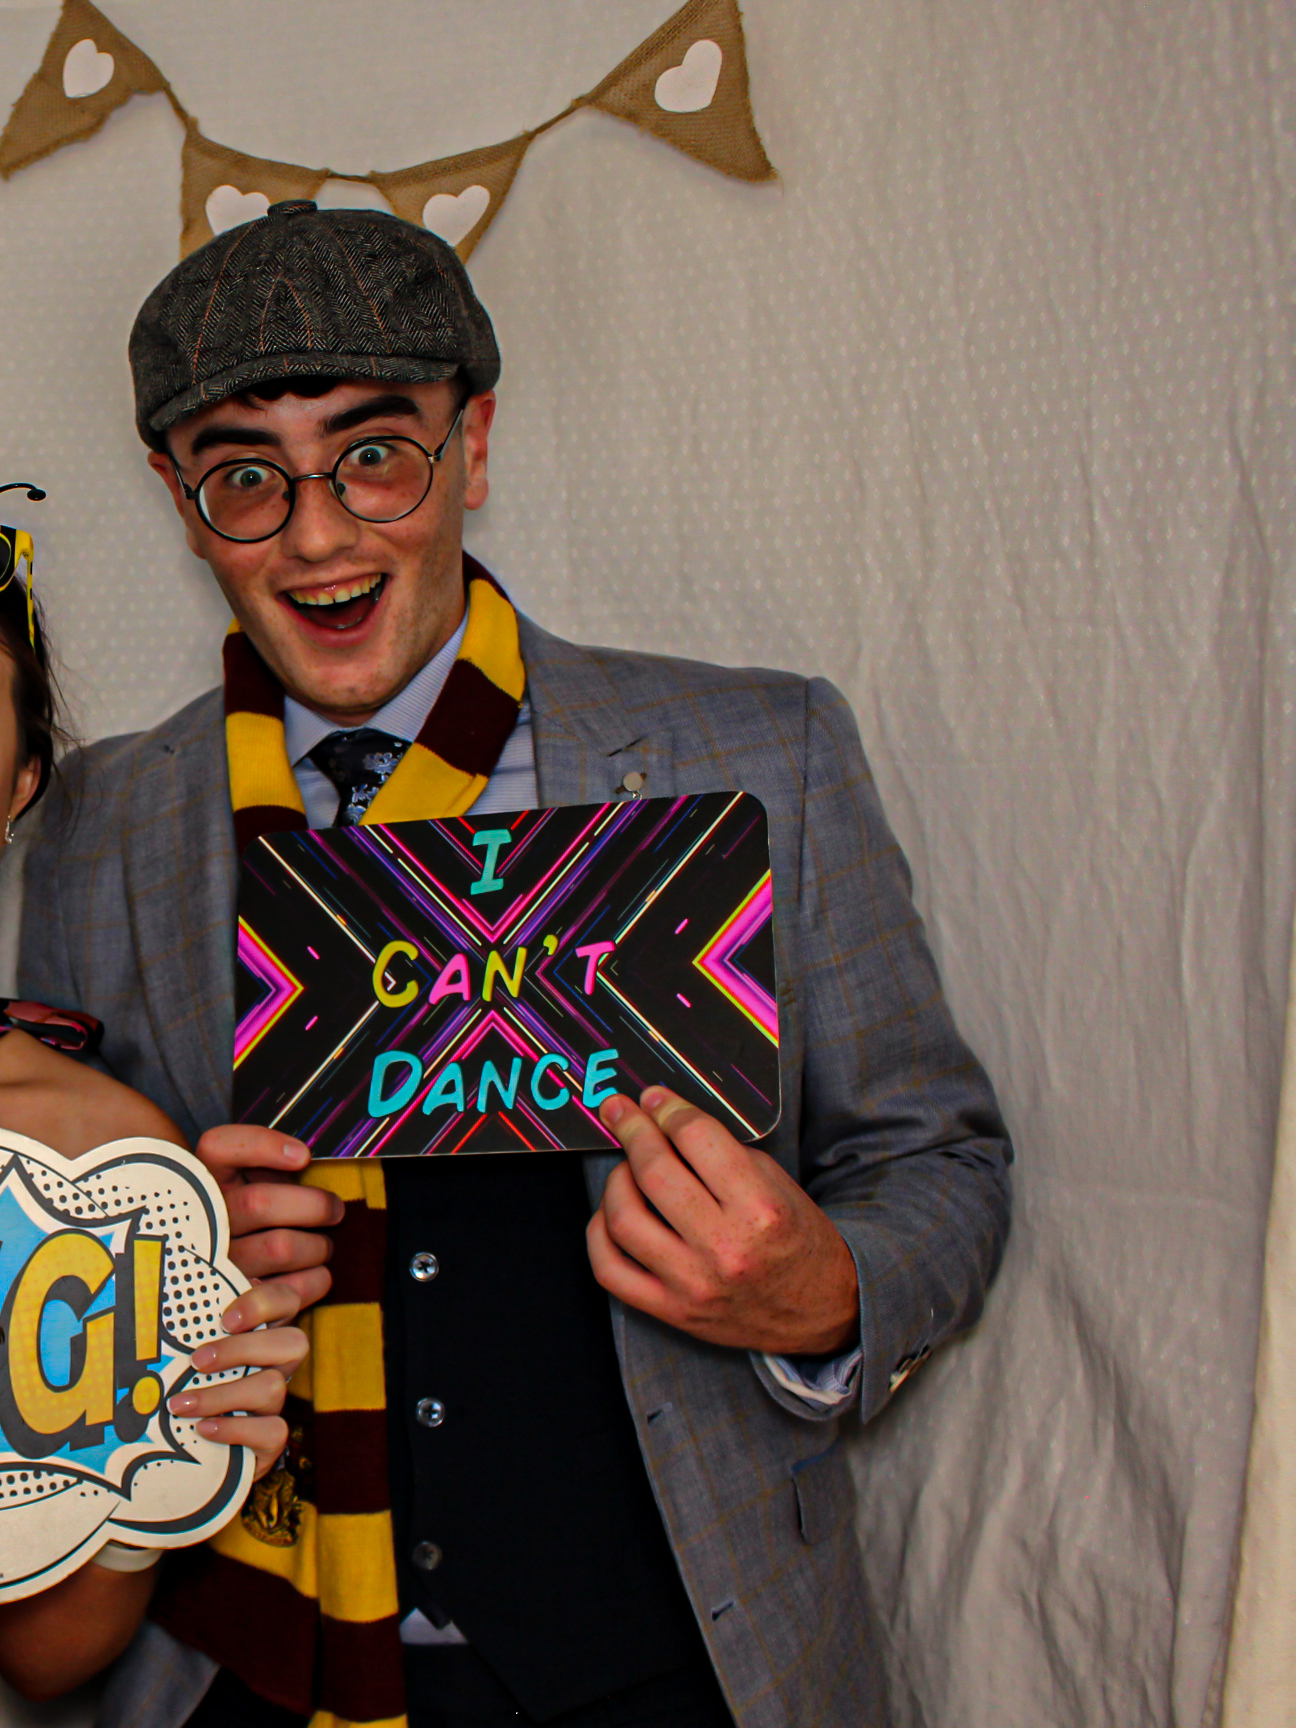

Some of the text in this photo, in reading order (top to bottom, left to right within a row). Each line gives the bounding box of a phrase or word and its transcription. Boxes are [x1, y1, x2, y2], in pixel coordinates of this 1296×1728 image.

[470, 828, 512, 895] I
[372, 934, 616, 1008] CAN'T
[367, 1048, 621, 1118] DANCE
